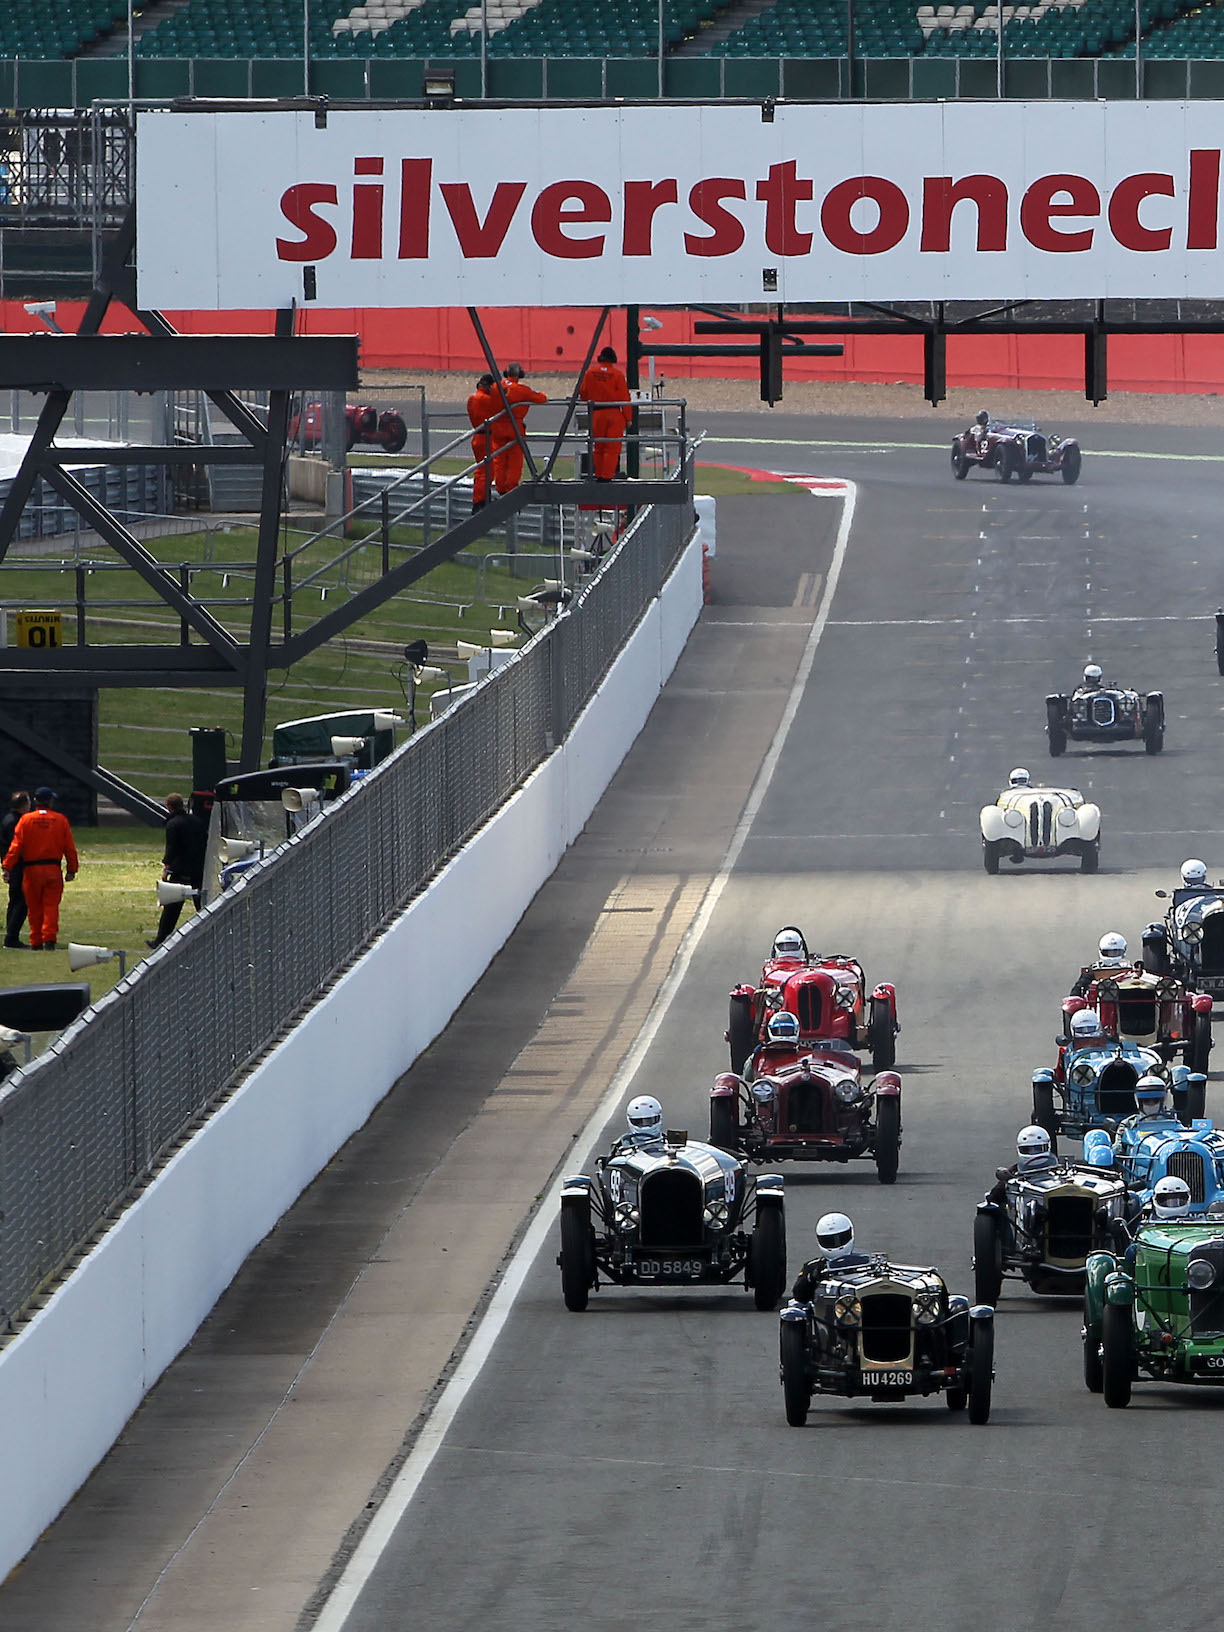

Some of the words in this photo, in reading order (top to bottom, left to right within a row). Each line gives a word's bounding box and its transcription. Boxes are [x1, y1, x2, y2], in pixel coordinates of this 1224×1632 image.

[28, 626, 58, 648] 10
[662, 1260, 702, 1274] 5849
[862, 1371, 913, 1385] HU4269
